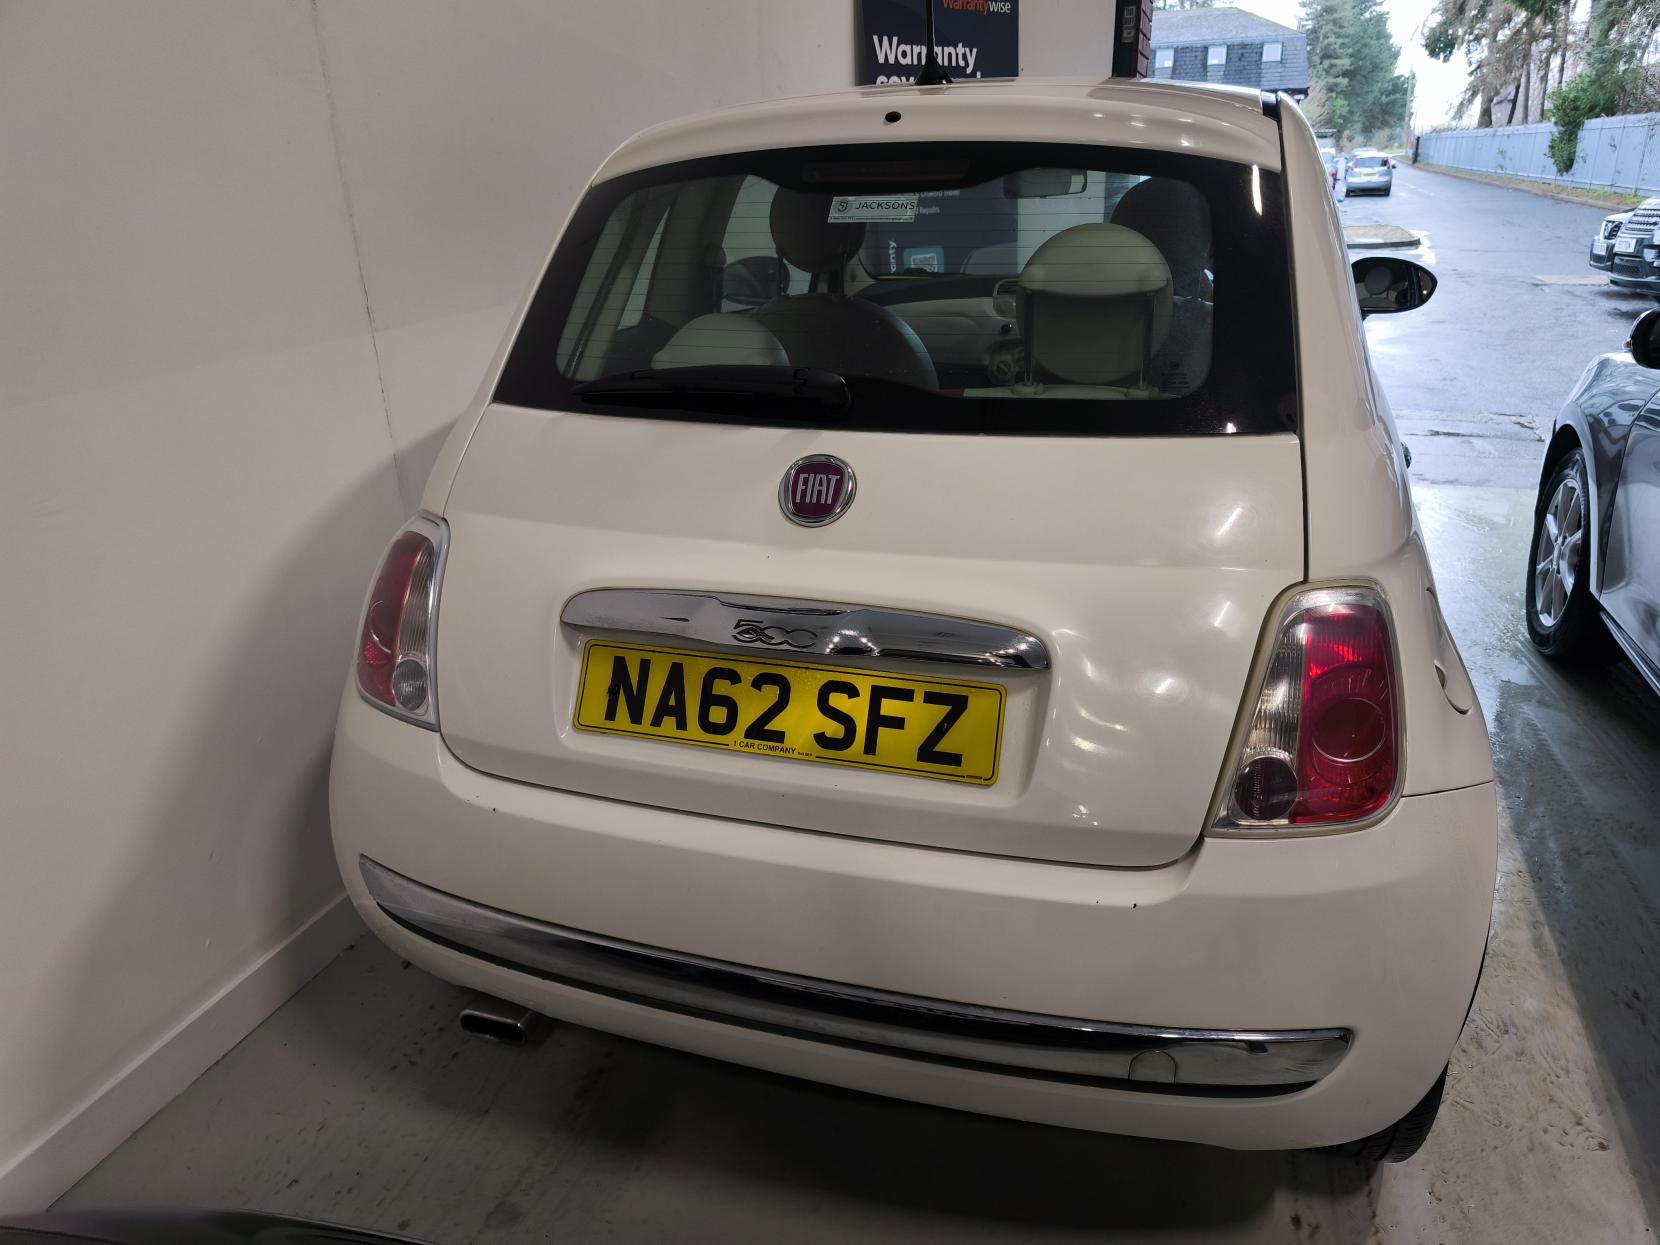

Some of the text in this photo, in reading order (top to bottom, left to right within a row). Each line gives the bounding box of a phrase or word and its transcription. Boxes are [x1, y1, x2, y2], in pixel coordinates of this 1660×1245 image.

[856, 201, 915, 210] JACKSONS
[796, 473, 840, 504] FIAT
[732, 619, 818, 648] 500
[604, 655, 969, 767] NA62 SFZ
[739, 741, 755, 750] CAR
[757, 743, 796, 755] COMPANY
